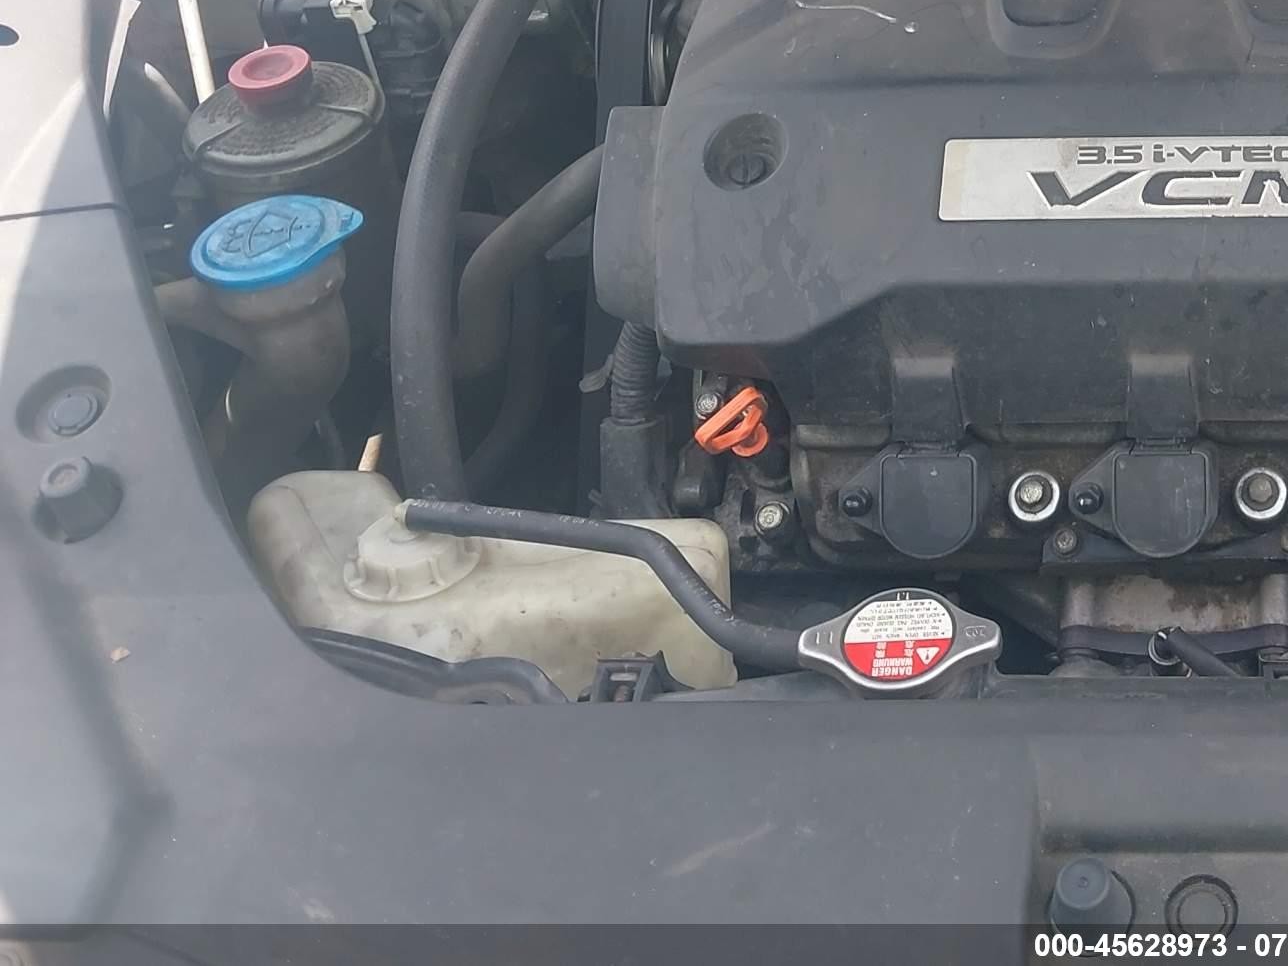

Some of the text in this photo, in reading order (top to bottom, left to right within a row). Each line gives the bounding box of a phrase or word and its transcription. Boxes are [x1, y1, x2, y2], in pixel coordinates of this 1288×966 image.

[1077, 145, 1143, 165] 3.5
[873, 658, 913, 667] WARNUNG
[872, 667, 912, 676] DANGER
